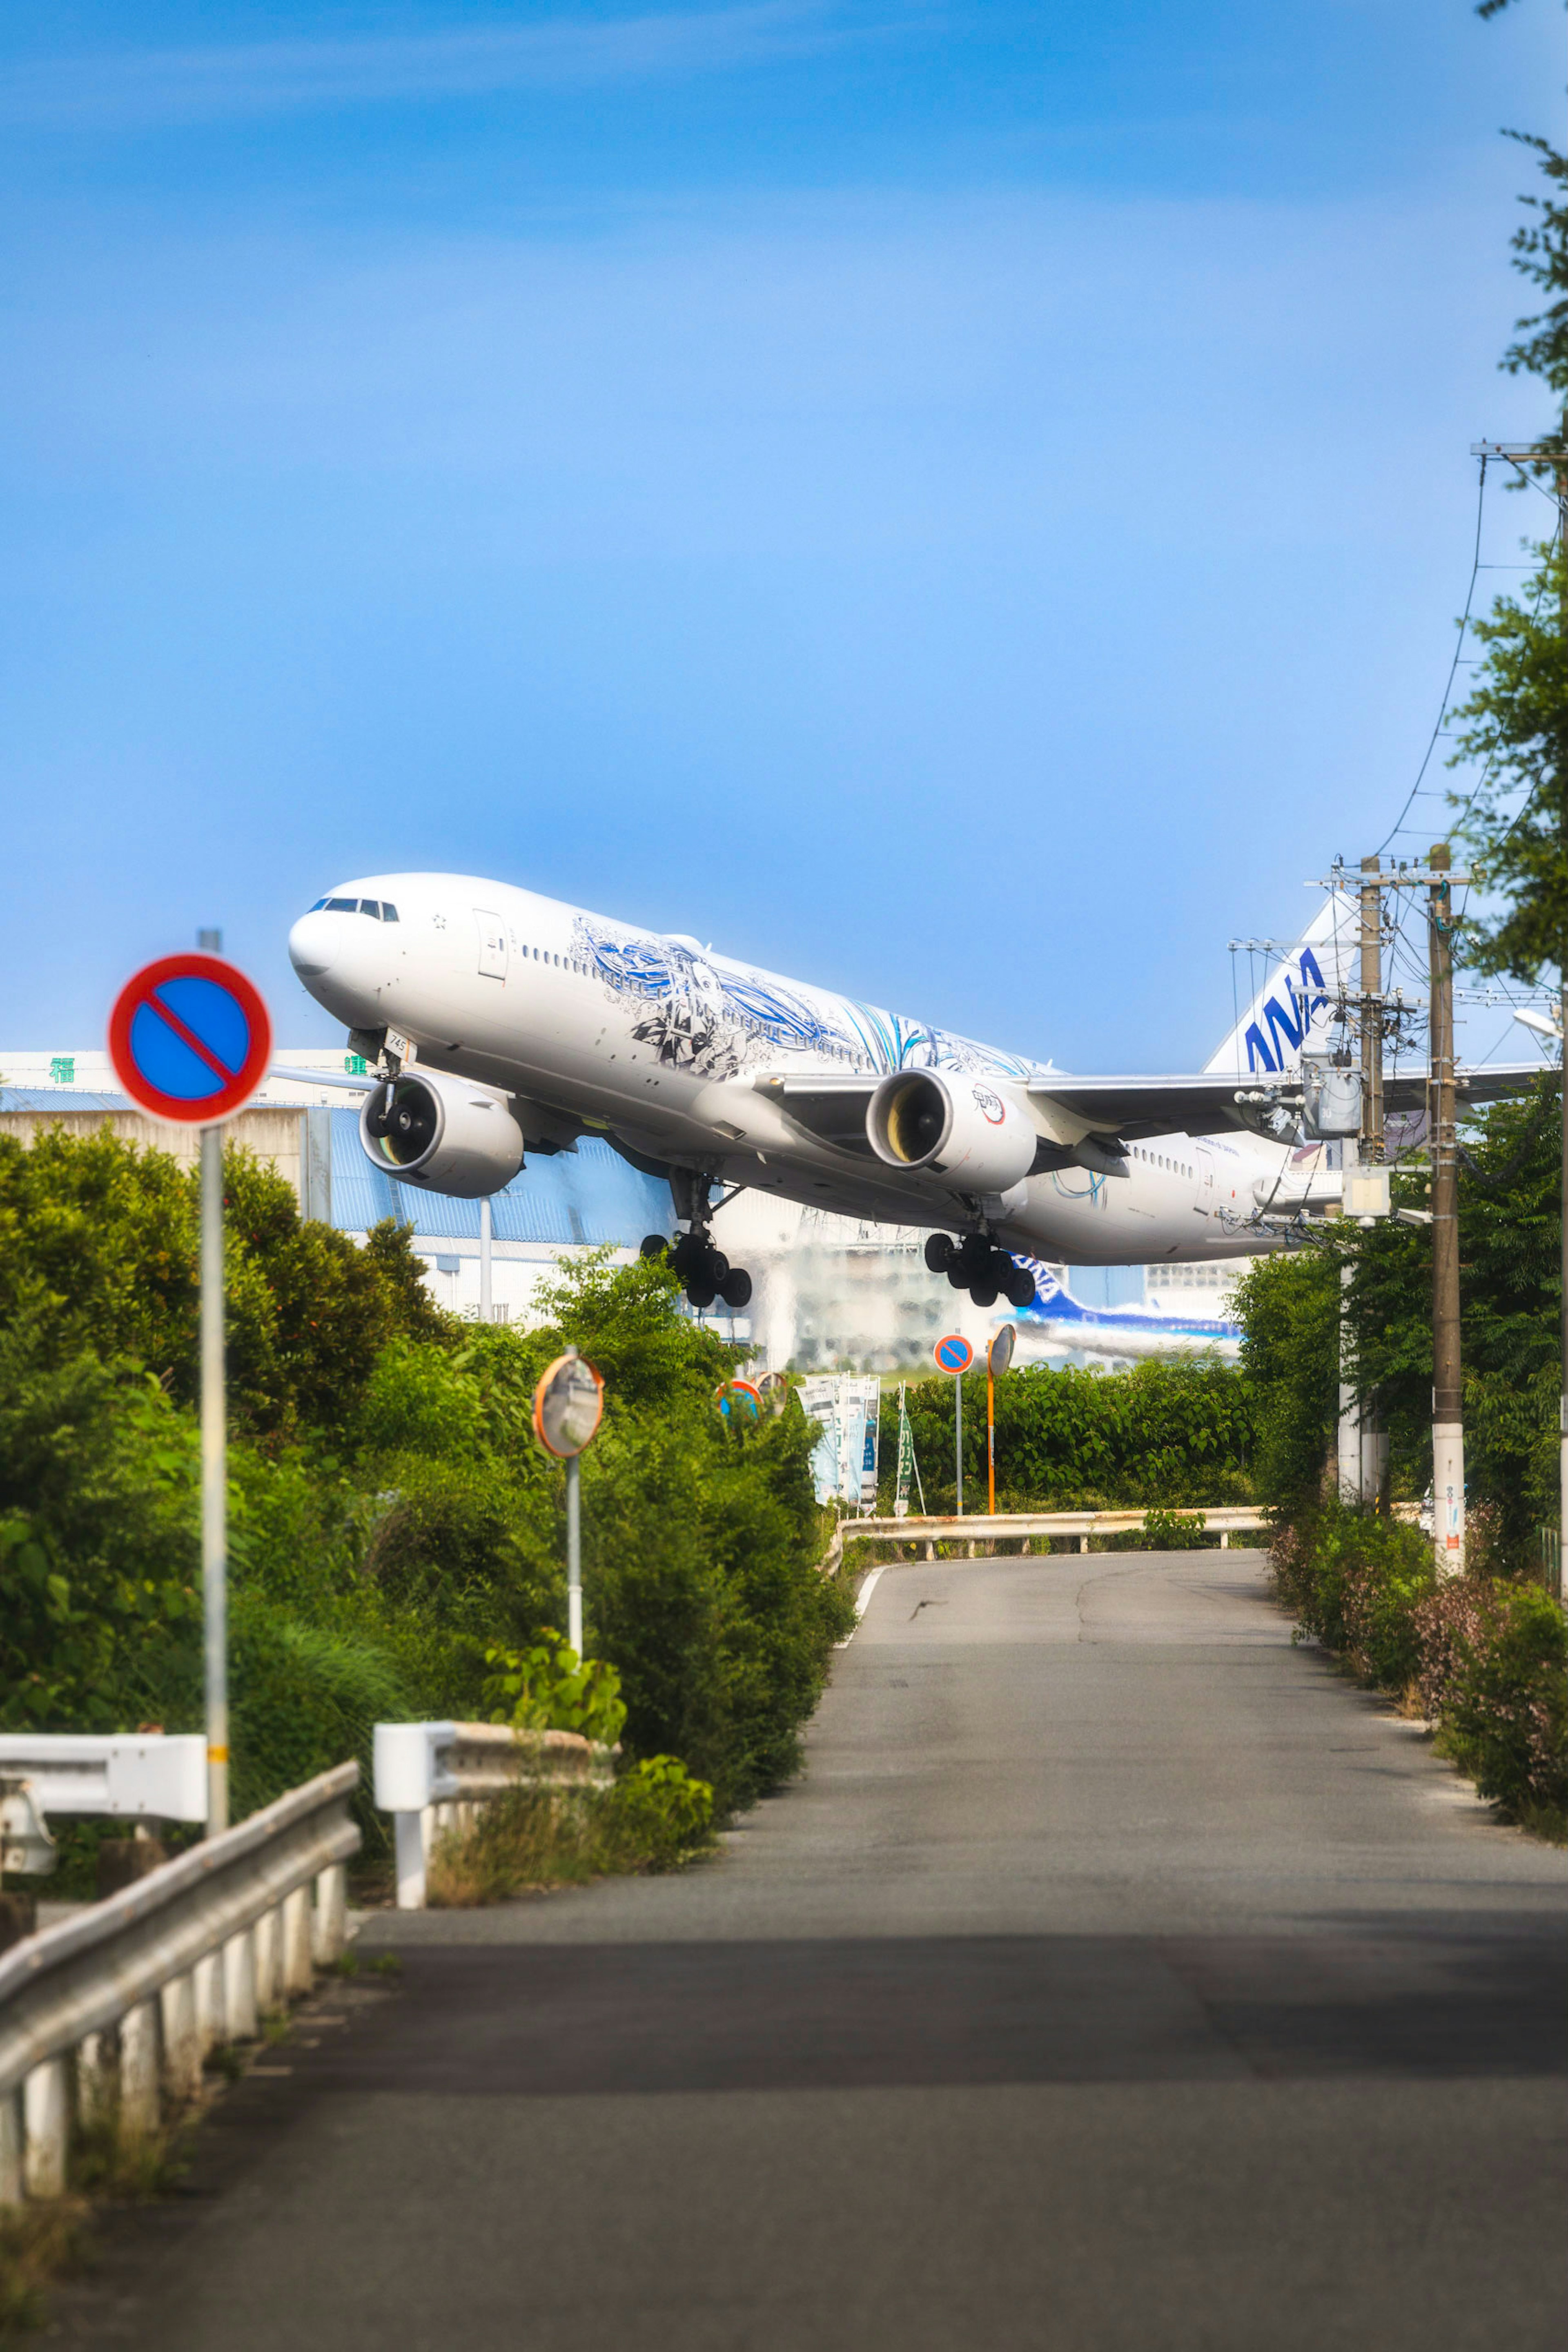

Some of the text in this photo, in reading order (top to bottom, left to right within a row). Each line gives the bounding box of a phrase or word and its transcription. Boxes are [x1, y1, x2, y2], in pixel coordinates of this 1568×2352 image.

[1245, 947, 1328, 1072] ANA
[390, 1035, 406, 1050] 745
[49, 1058, 74, 1083] 福
[1322, 1108, 1331, 1118] 30
